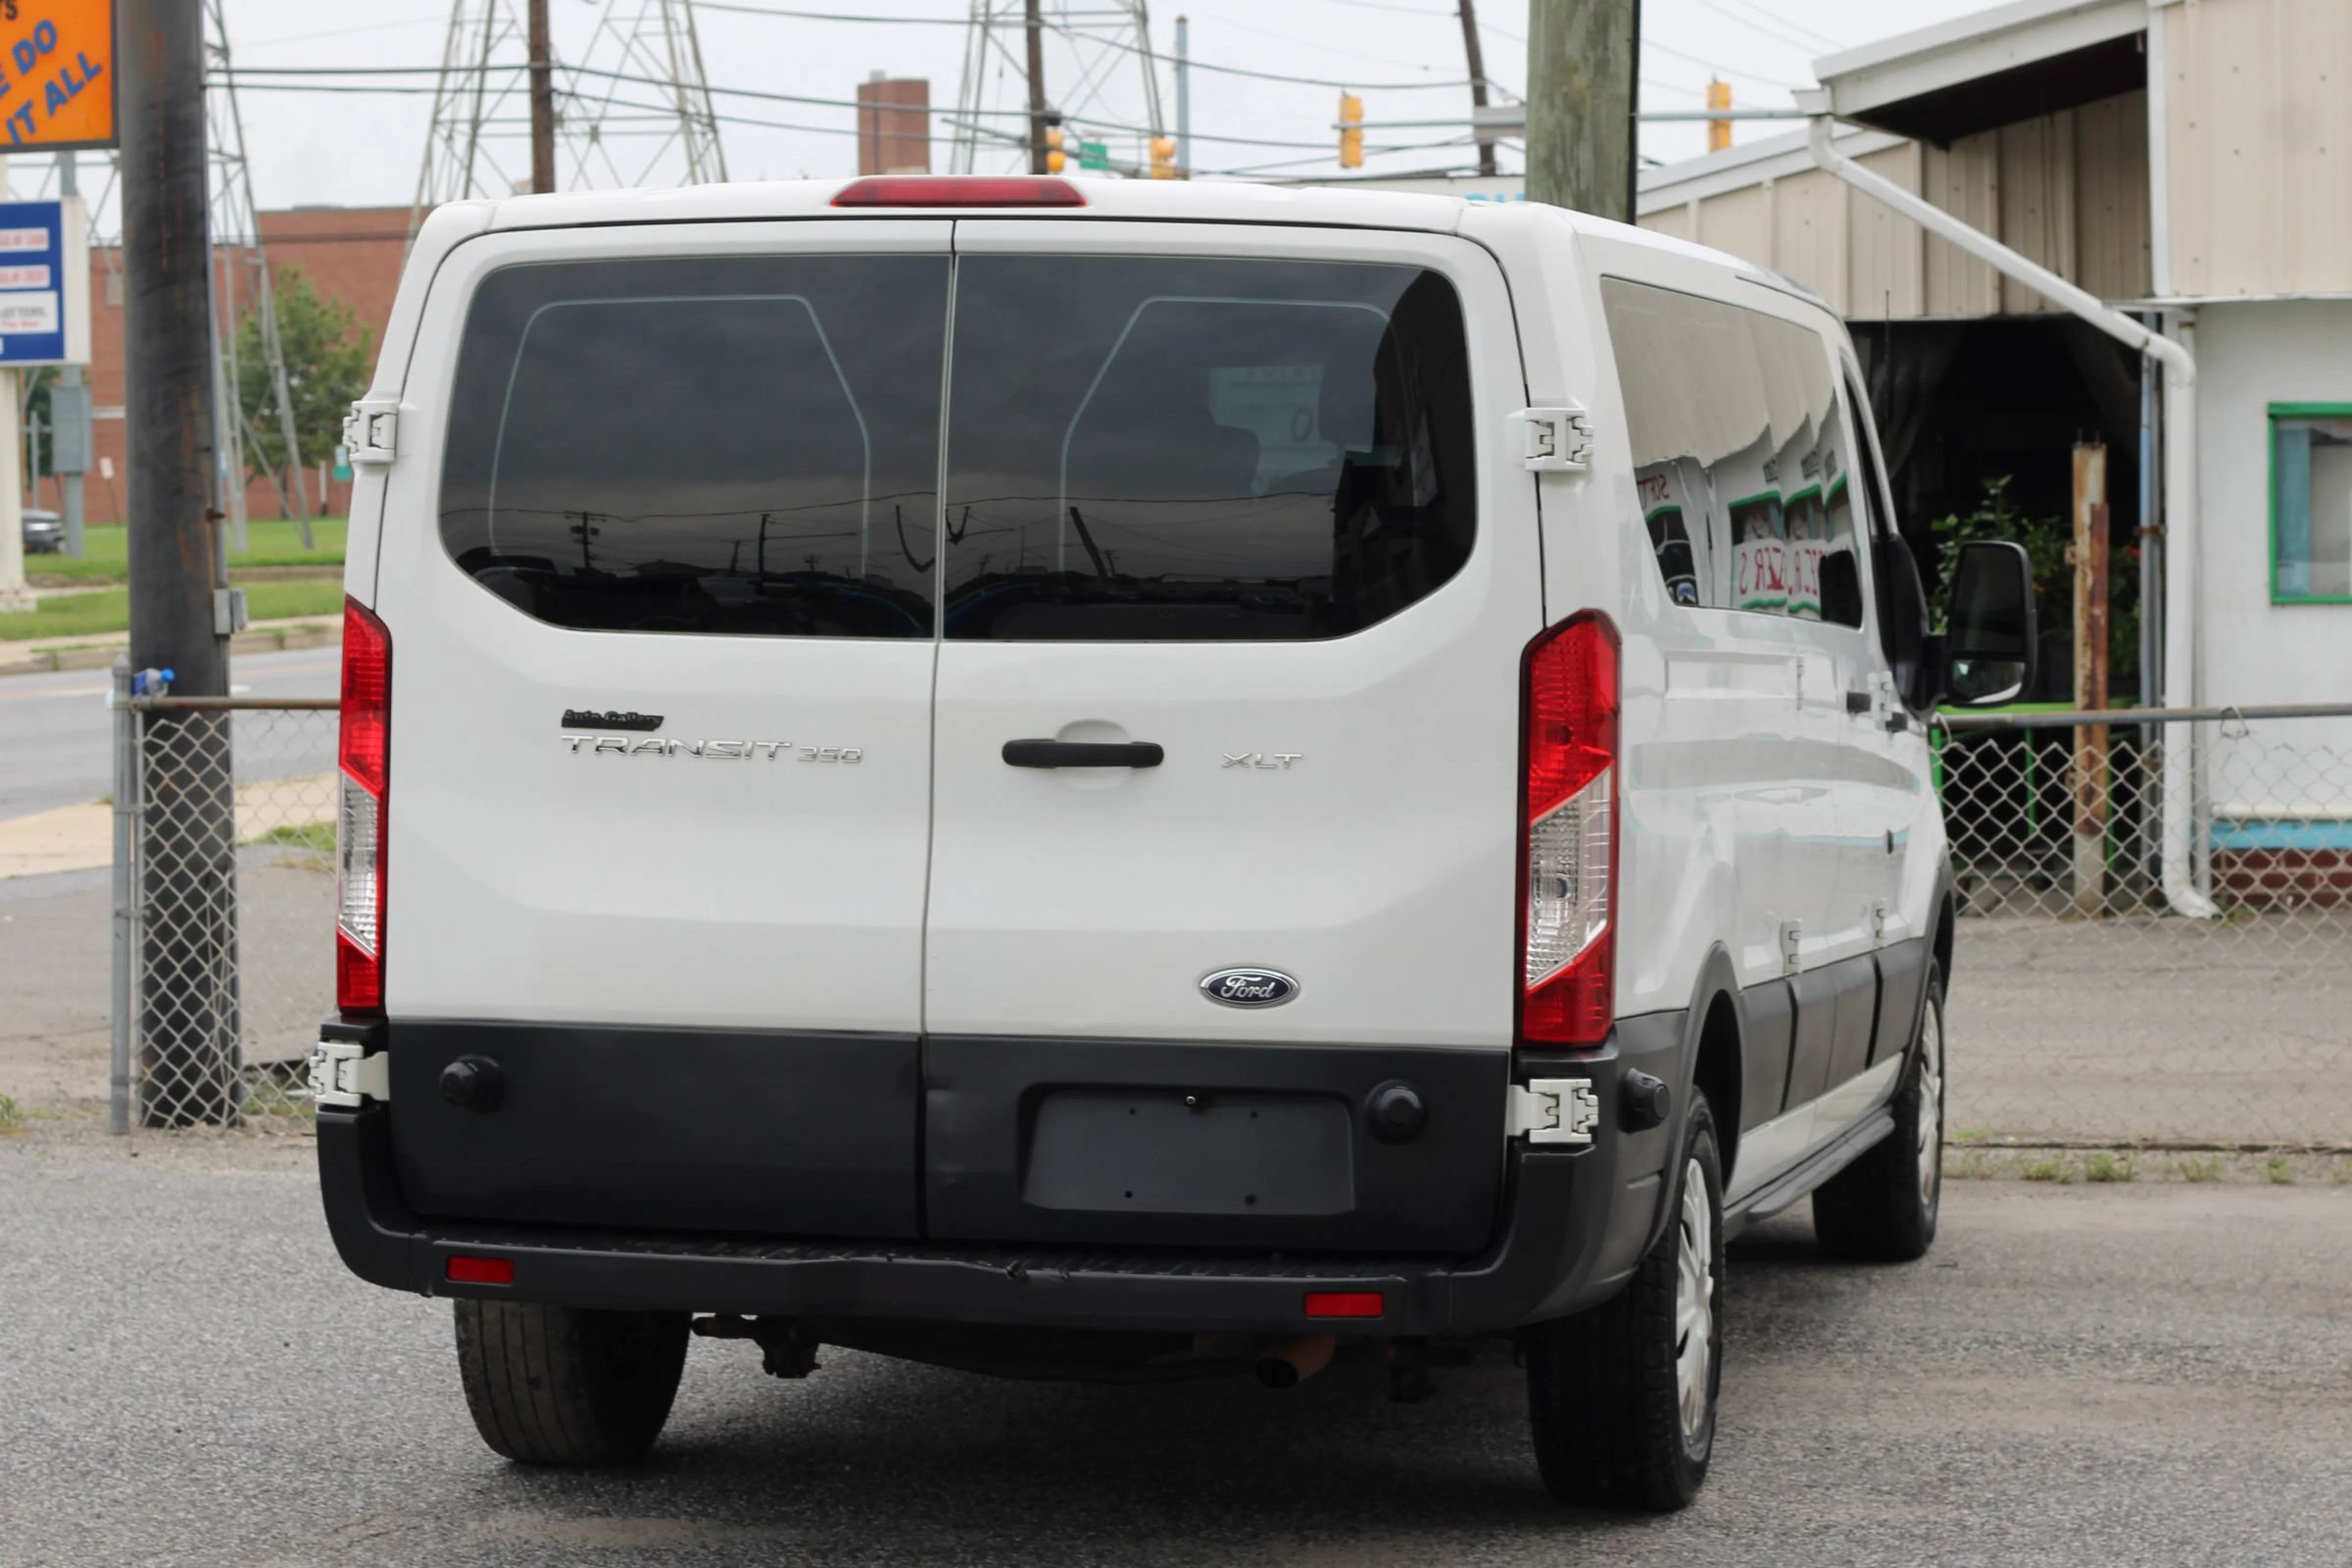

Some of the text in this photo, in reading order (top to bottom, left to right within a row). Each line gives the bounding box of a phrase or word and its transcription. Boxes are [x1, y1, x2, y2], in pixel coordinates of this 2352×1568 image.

[13, 20, 57, 74] DO
[6, 51, 102, 143] IT ALL
[560, 735, 862, 762] TRANSIT 350
[1221, 752, 1303, 769] XLT
[1220, 975, 1276, 998] Ford
